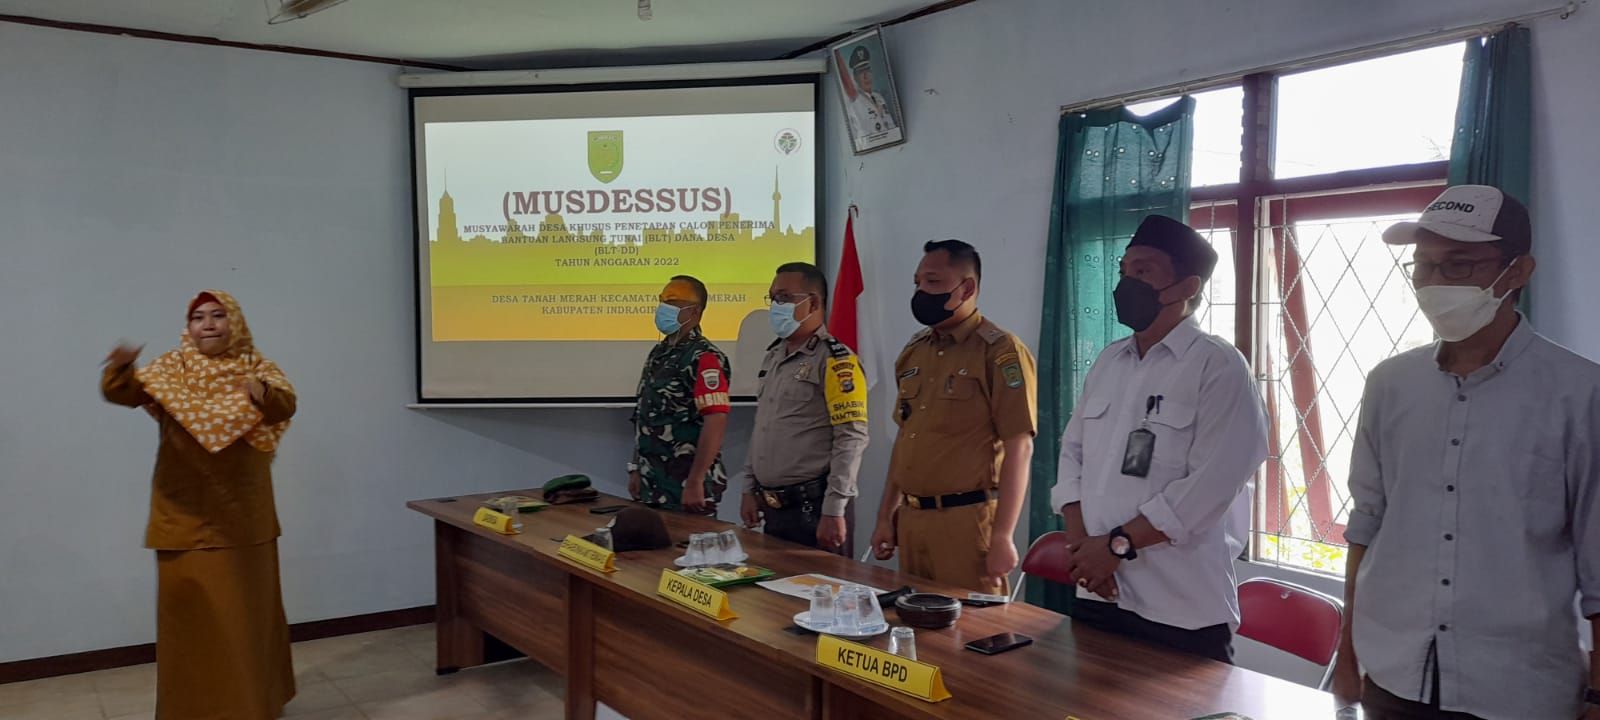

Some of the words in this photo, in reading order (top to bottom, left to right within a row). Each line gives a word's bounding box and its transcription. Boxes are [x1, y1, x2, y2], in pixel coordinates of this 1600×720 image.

[502, 187, 732, 221] (MUSDESSUS)
[463, 224, 536, 233] MUSYAWARAH
[539, 223, 567, 232] DESA
[569, 222, 612, 231] KHUSUS
[615, 221, 677, 231] PENETAPAN
[679, 221, 716, 230] CALON
[719, 220, 776, 230] PENERIMA
[501, 235, 549, 244] BANTUAN
[552, 234, 607, 243] LANGSUNG
[611, 234, 642, 243] TUNAI
[645, 233, 672, 244] (BLT)
[674, 233, 703, 242] DANA
[706, 233, 736, 242] DESA
[594, 246, 639, 256] (BLT-DD)
[555, 258, 590, 267] TAHUN
[593, 257, 651, 267] ANGGARAN
[653, 257, 680, 266] 2022
[491, 295, 519, 304] DESA
[521, 294, 556, 303] TANAH
[559, 294, 597, 303] MERAH
[600, 294, 660, 303] KECAMATA
[708, 294, 746, 302] MERAH
[541, 306, 603, 315] KABUPATEN
[667, 578, 693, 599] KEPALA
[693, 588, 713, 608] DESA
[838, 646, 879, 675] KETUA
[882, 661, 908, 683] BPD
